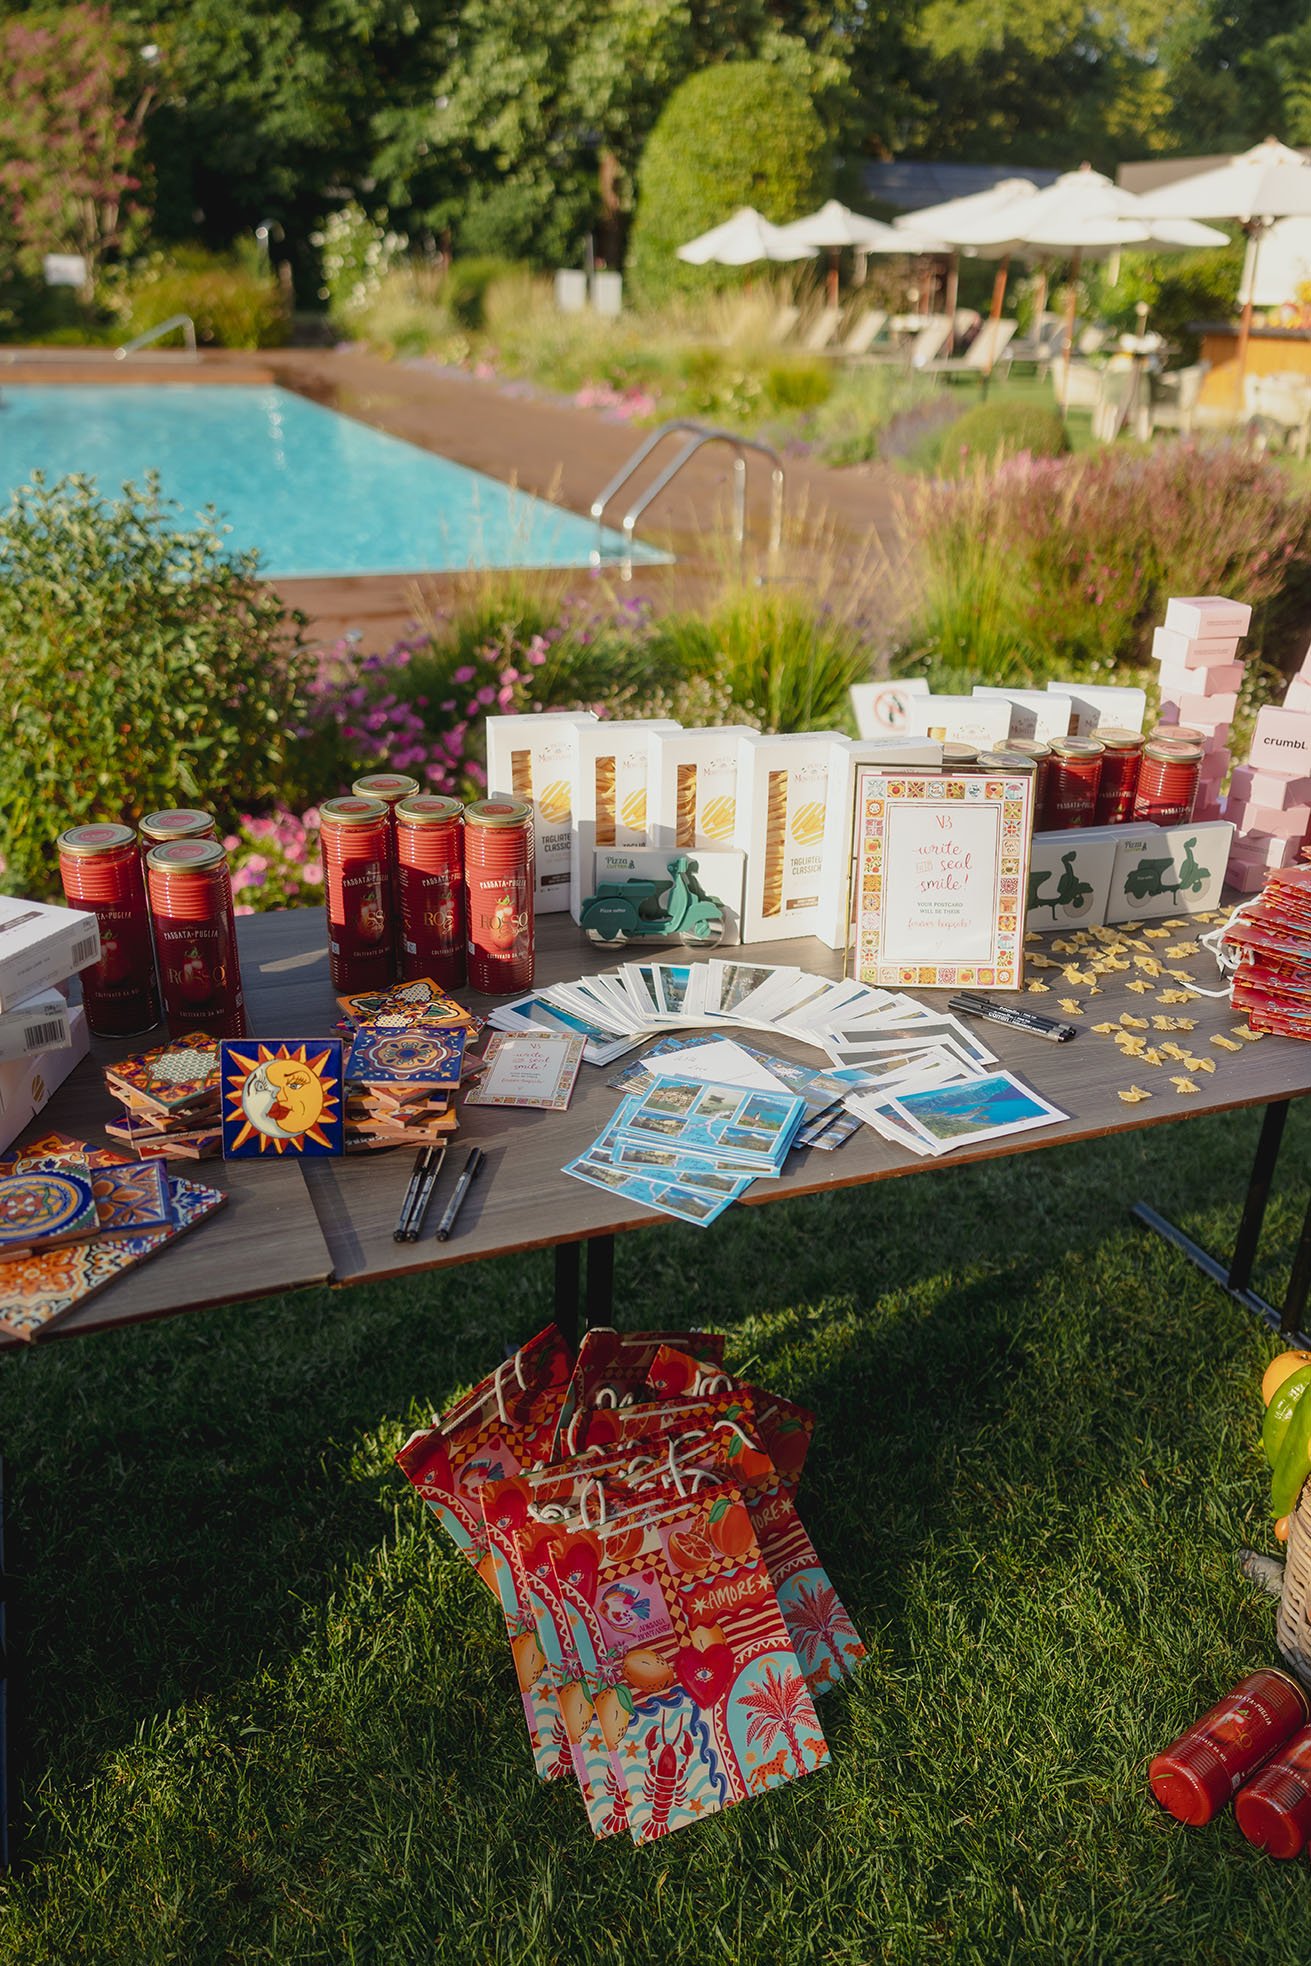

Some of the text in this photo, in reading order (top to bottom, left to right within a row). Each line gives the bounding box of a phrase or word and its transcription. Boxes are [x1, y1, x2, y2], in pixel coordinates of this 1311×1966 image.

[541, 832, 571, 845] TAGLIATE
[544, 841, 571, 853] CLASSIC
[605, 856, 628, 865] Pizza
[940, 852, 974, 871] seal
[706, 1573, 757, 1609] AMORE
